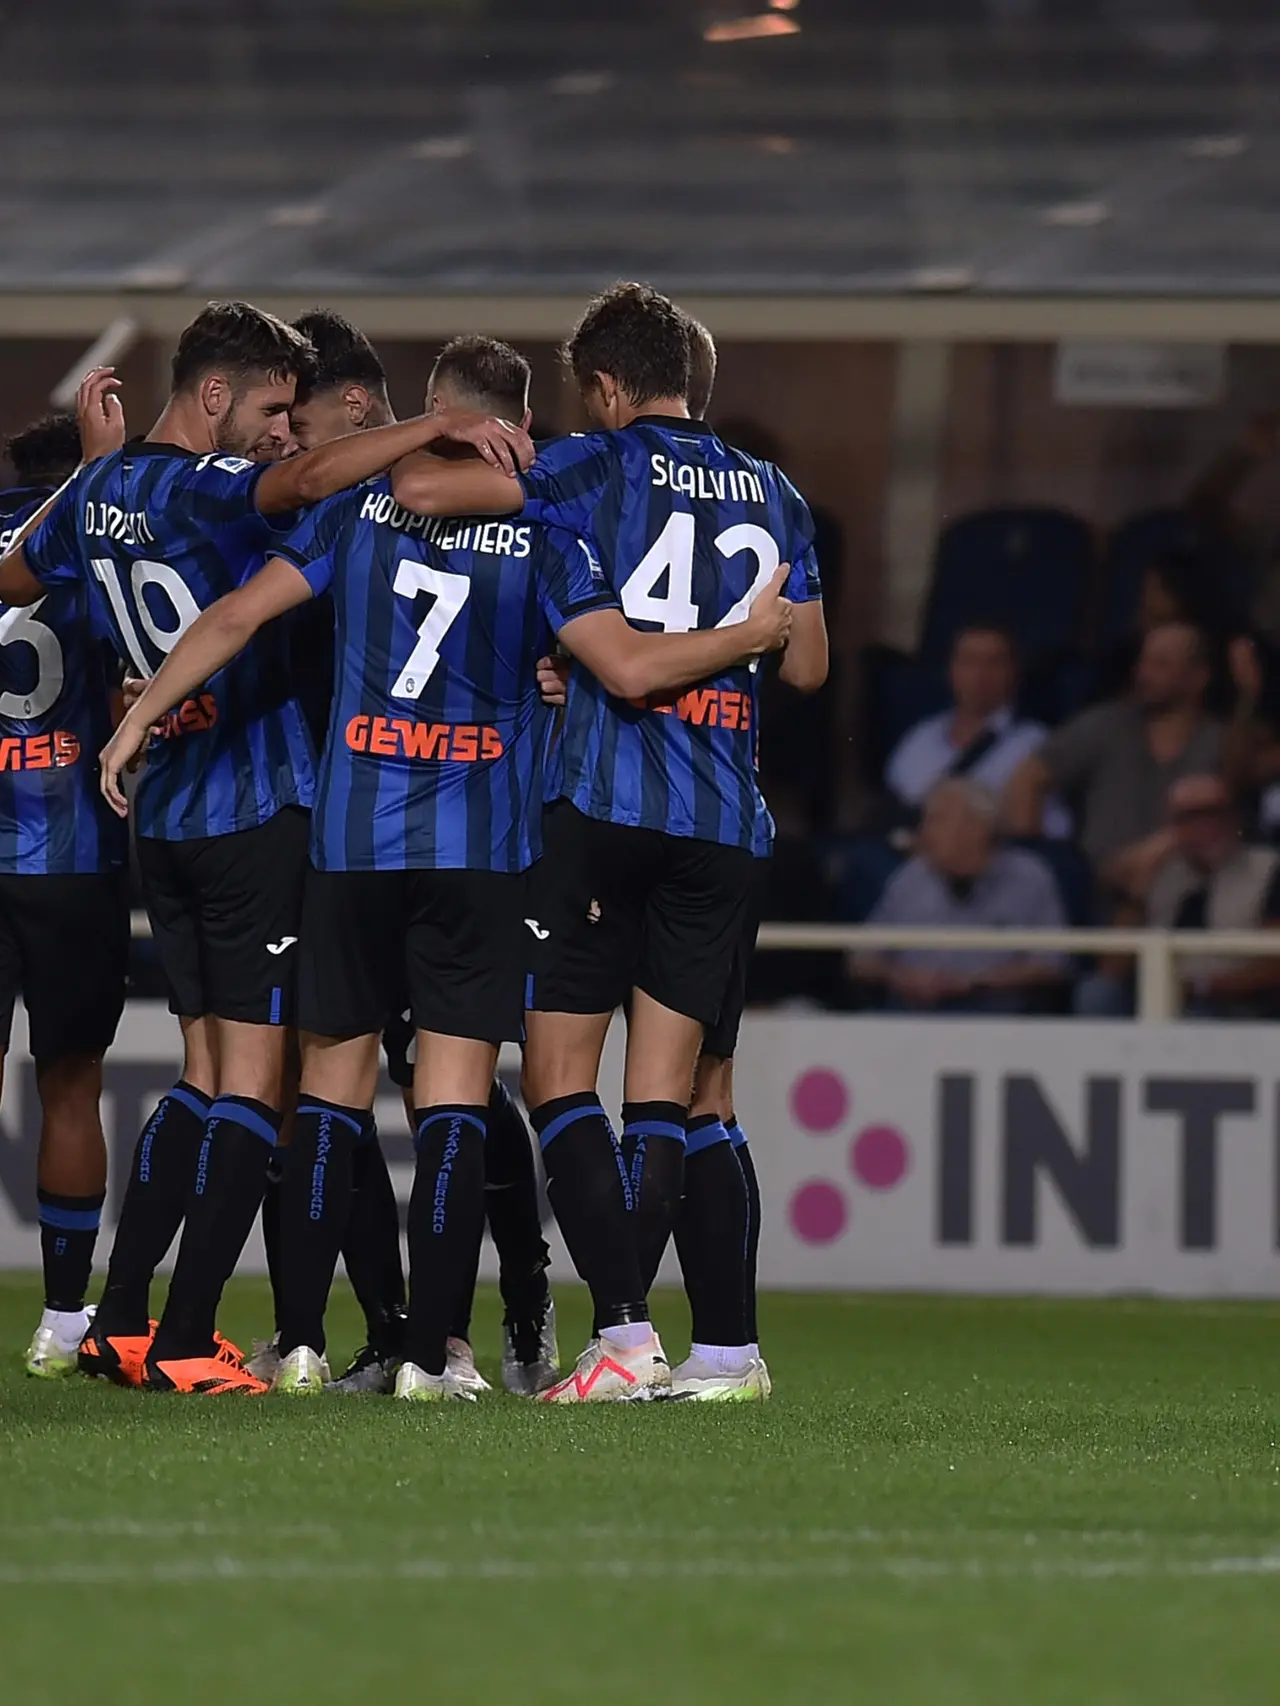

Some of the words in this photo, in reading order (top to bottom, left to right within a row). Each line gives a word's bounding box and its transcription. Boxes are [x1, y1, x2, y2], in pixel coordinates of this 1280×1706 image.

[651, 453, 765, 504] SCALVINI
[391, 558, 471, 700] 7
[621, 511, 780, 674] 42
[432, 1171, 449, 1234] BERGAMO
[936, 1071, 1280, 1252] INT
